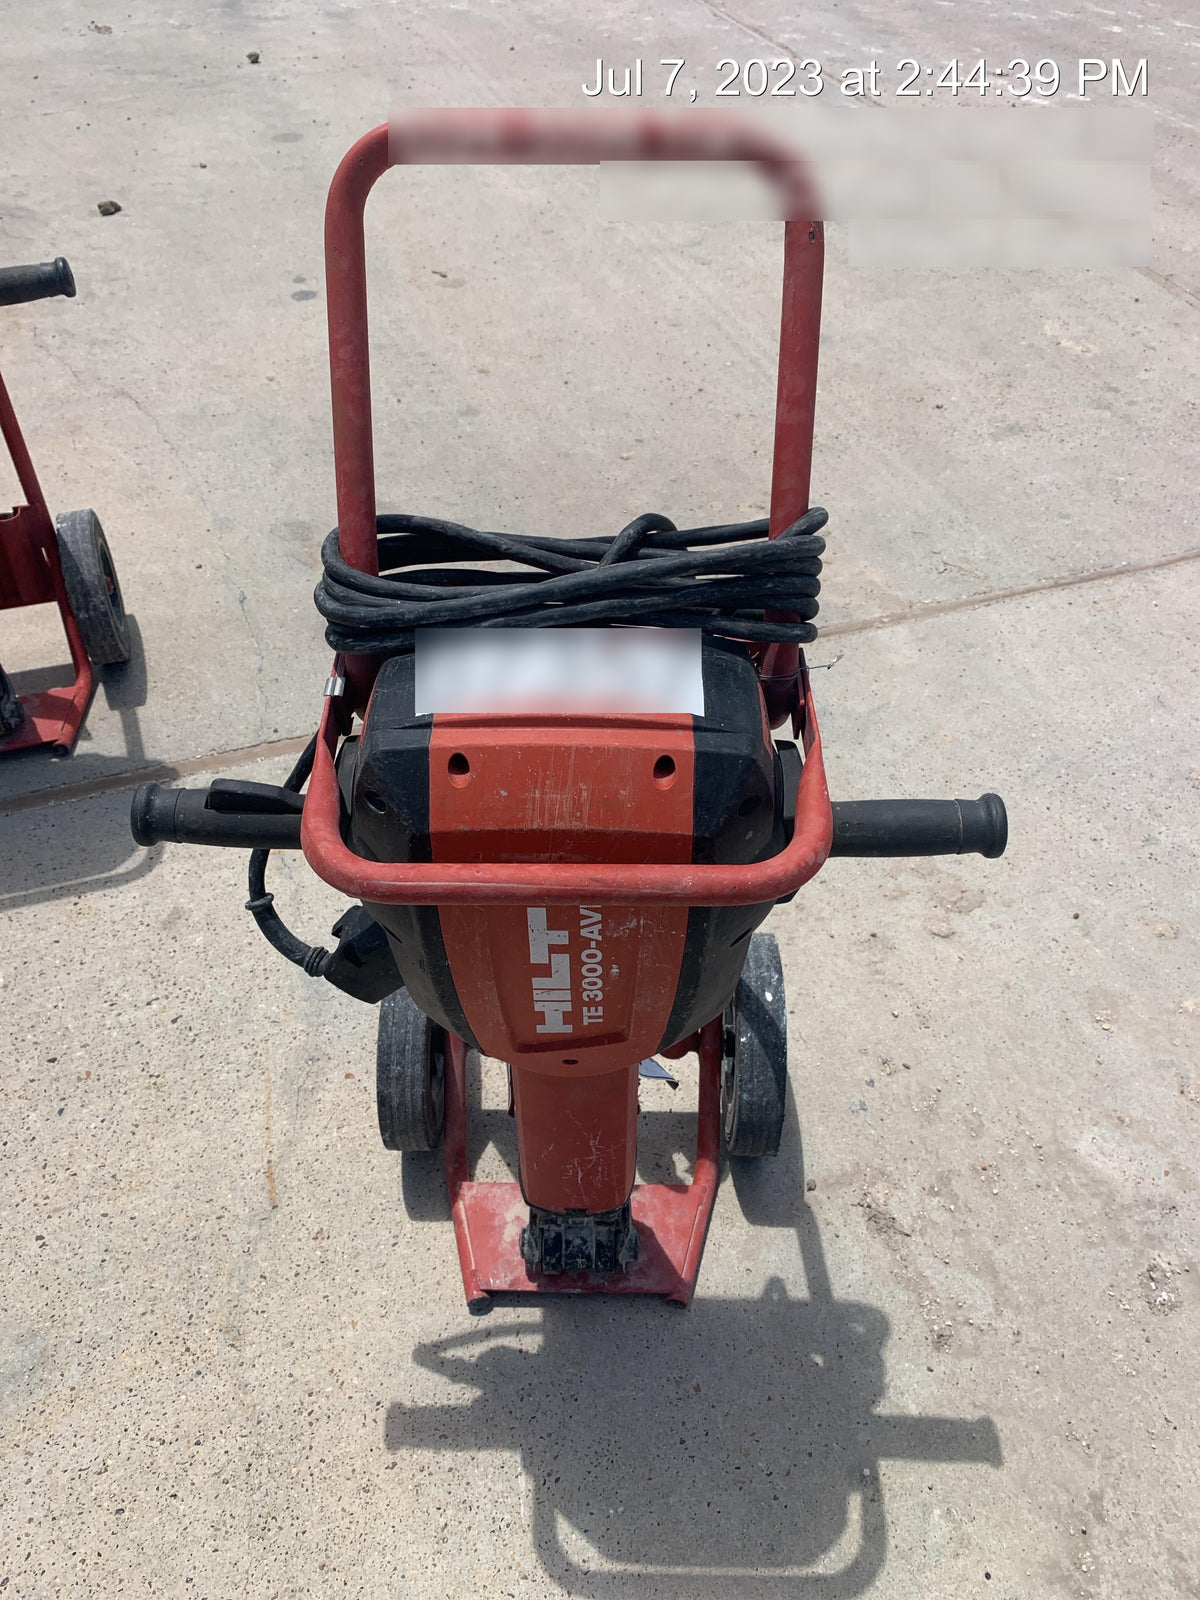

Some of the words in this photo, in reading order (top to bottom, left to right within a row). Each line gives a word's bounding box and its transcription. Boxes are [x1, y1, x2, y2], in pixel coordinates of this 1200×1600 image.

[527, 907, 573, 1033] HILT
[579, 904, 604, 1002] 3000-AV
[583, 1006, 604, 1026] TE
